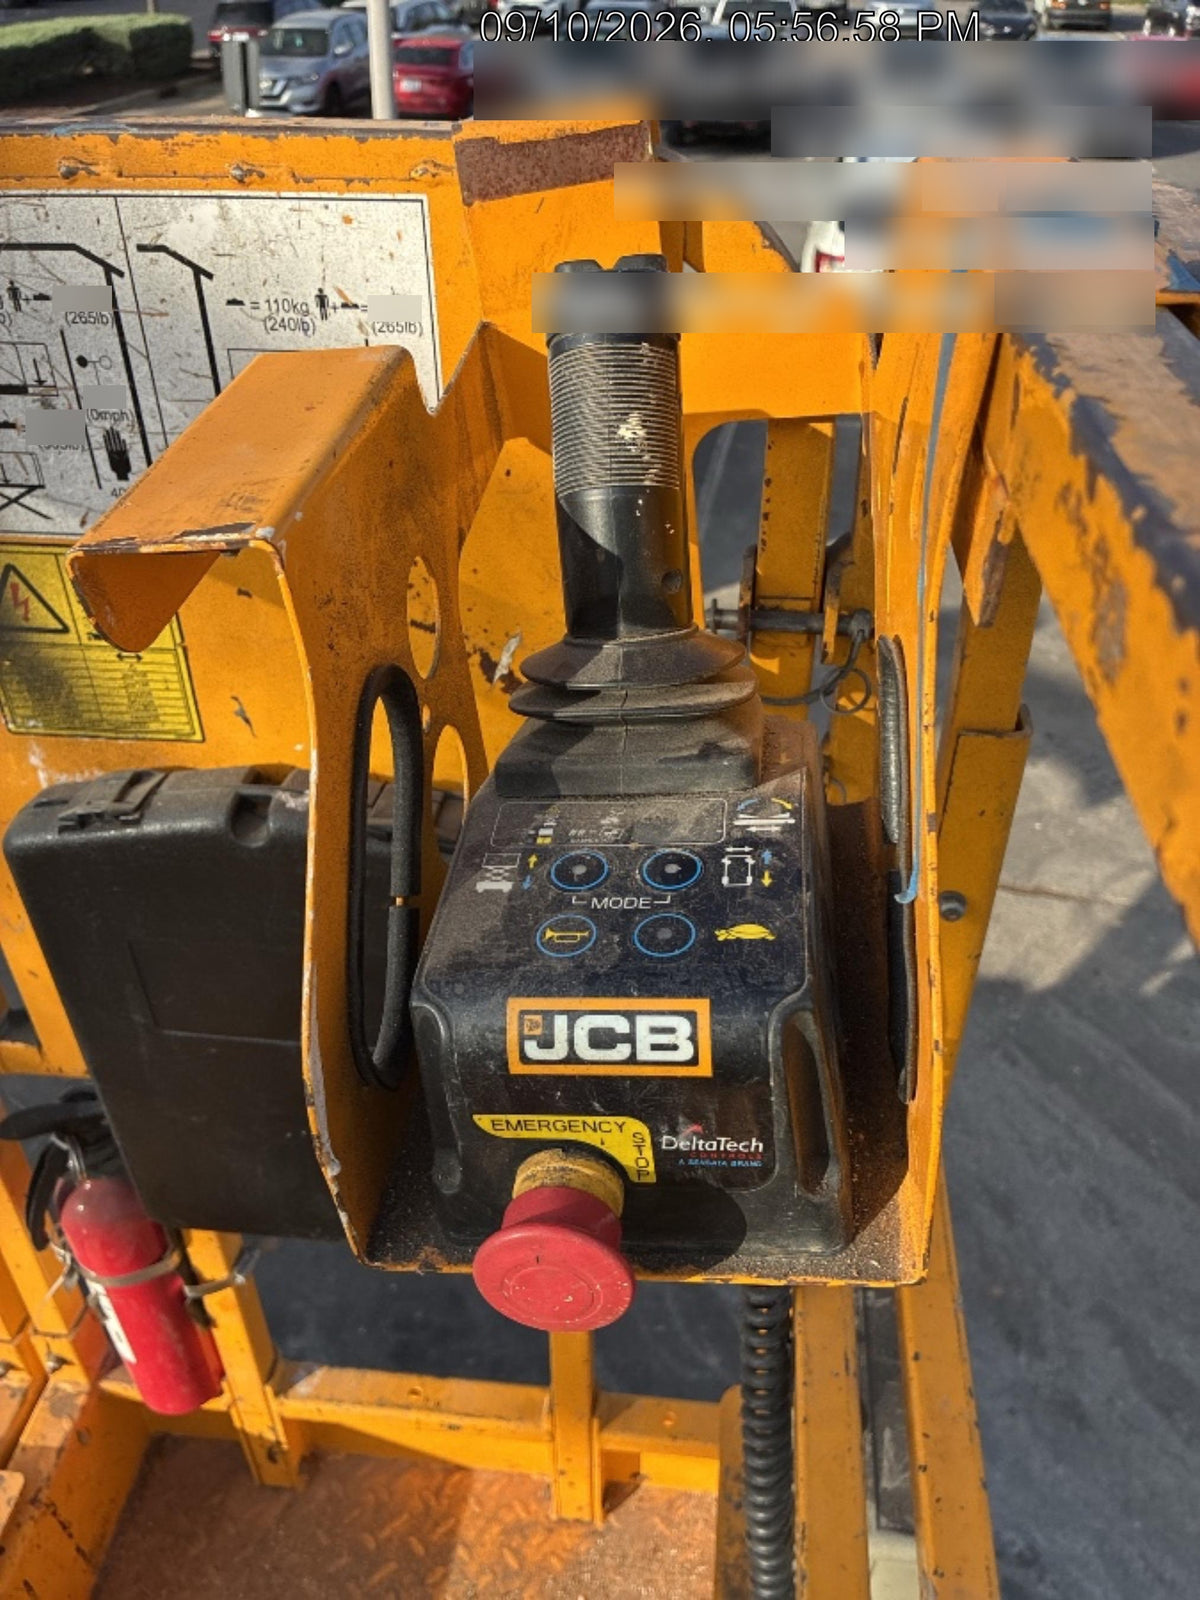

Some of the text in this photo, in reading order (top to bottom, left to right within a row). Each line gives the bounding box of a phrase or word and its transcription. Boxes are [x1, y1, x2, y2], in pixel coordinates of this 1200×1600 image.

[265, 298, 310, 316] 110kg
[264, 316, 316, 336] (240lb)
[591, 897, 652, 910] MODE
[523, 1014, 694, 1062] JCB
[490, 1119, 627, 1134] EMERGENCY
[661, 1135, 764, 1152] DeltaTech
[632, 1132, 650, 1181] STOP
